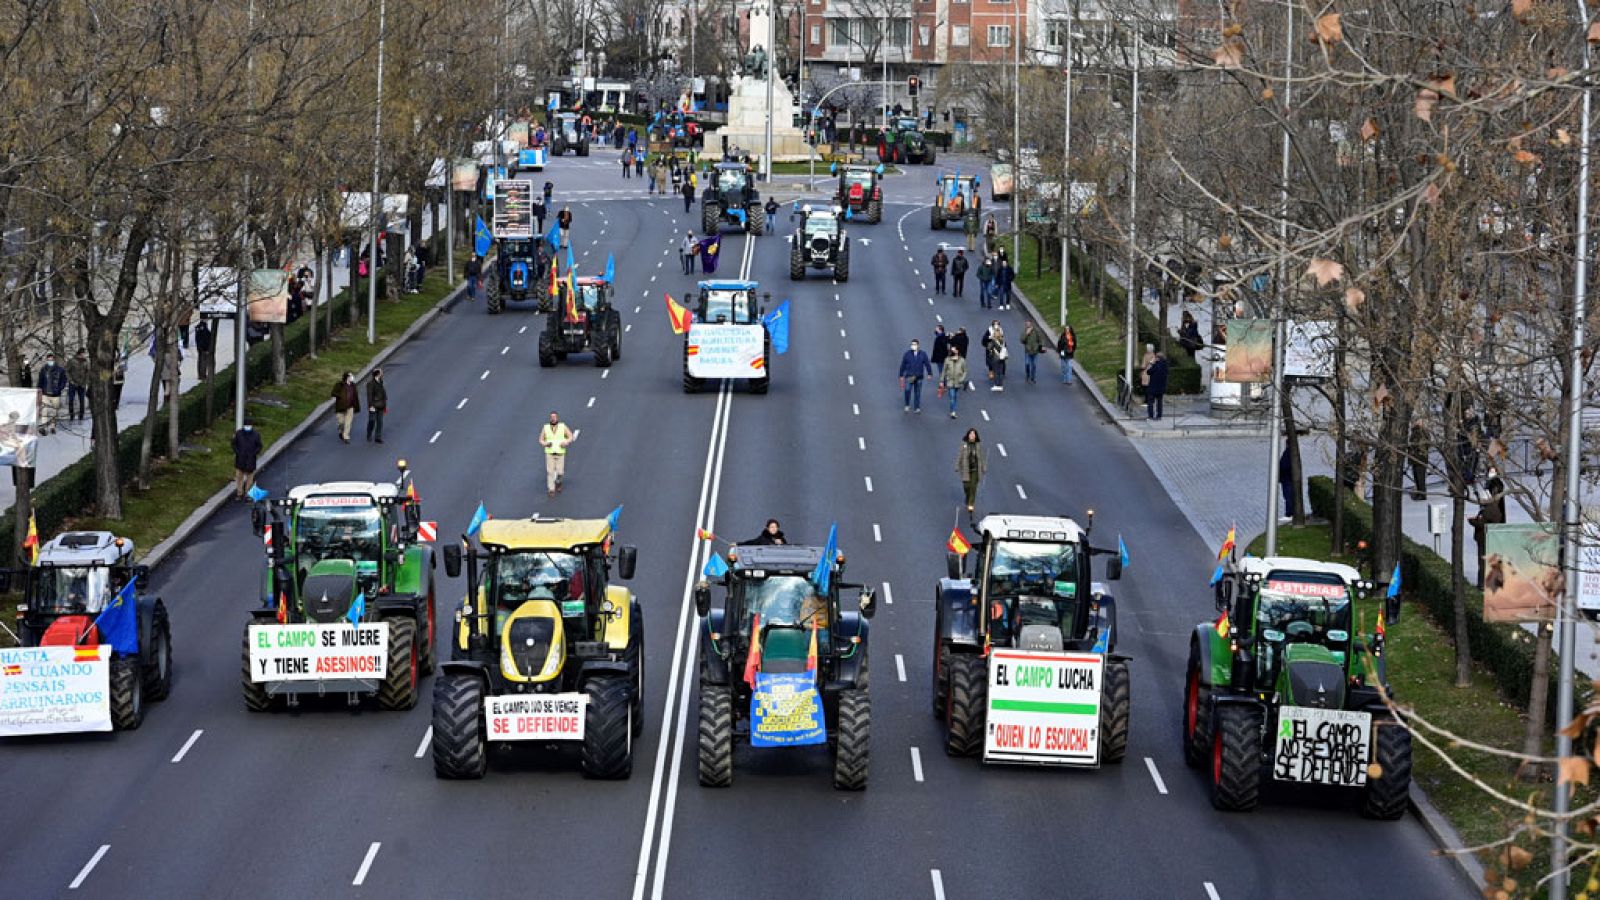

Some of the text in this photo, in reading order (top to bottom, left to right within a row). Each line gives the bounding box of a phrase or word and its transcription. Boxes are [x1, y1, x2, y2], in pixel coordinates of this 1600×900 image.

[1274, 583, 1338, 595] ASTURIAS
[257, 629, 380, 648] EL CAMPO SE MUERE
[1, 651, 48, 664] HASTA
[259, 655, 381, 674] Y TIENE ASESINOS!!
[30, 663, 93, 677] CUANDO
[996, 664, 1095, 690] EL CAMPO LUCHA
[0, 691, 102, 709] ARRUINARNOS
[493, 700, 579, 714] EL CAMPO NO SE VENDE
[493, 716, 579, 733] SE DEFIENDE
[1293, 720, 1361, 745] EL CAMPO
[1028, 726, 1041, 748] LO
[1282, 739, 1366, 764] NO SE VENDE
[1275, 756, 1368, 784] SE DEFIENDE
